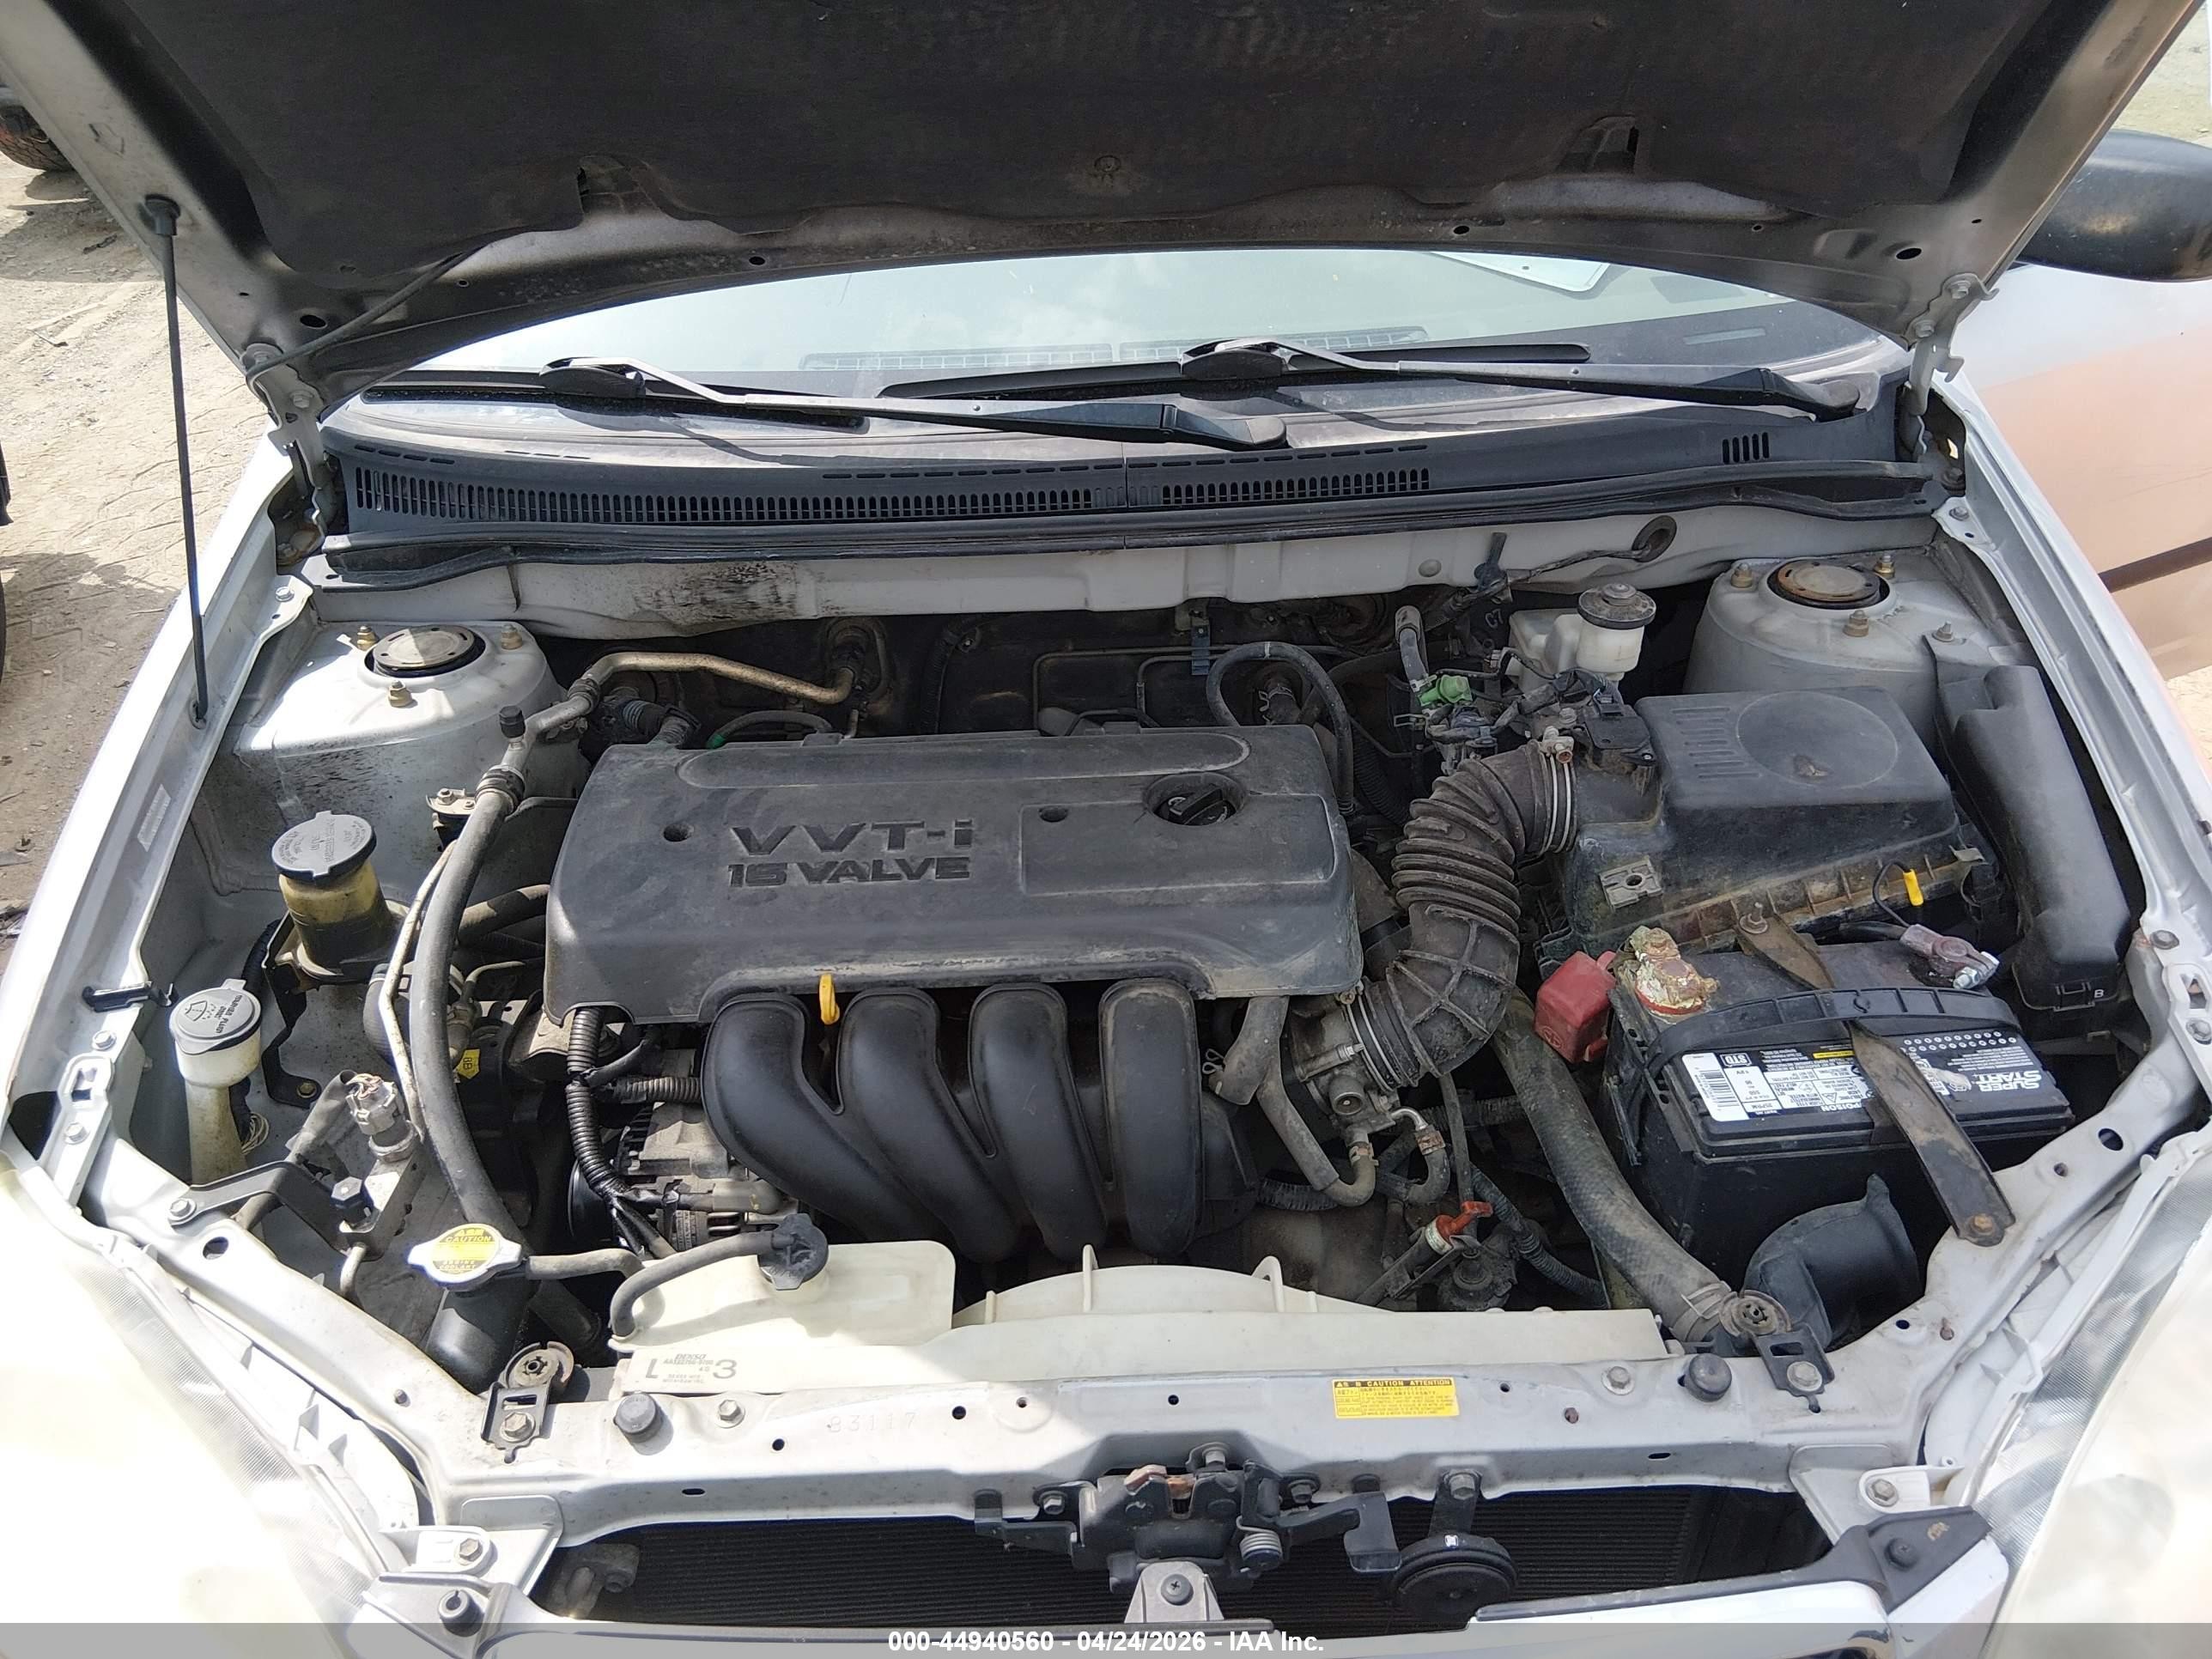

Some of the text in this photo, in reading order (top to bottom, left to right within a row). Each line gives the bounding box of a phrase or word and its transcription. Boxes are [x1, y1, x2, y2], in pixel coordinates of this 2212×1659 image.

[731, 818, 974, 855] VVT-i
[727, 856, 971, 888] 16 VALVE
[2094, 988, 2105, 999] B
[1724, 1054, 1748, 1065] STD
[1978, 1082, 2040, 1092] SUPER
[645, 1358, 659, 1379] L
[713, 1358, 738, 1380] 3
